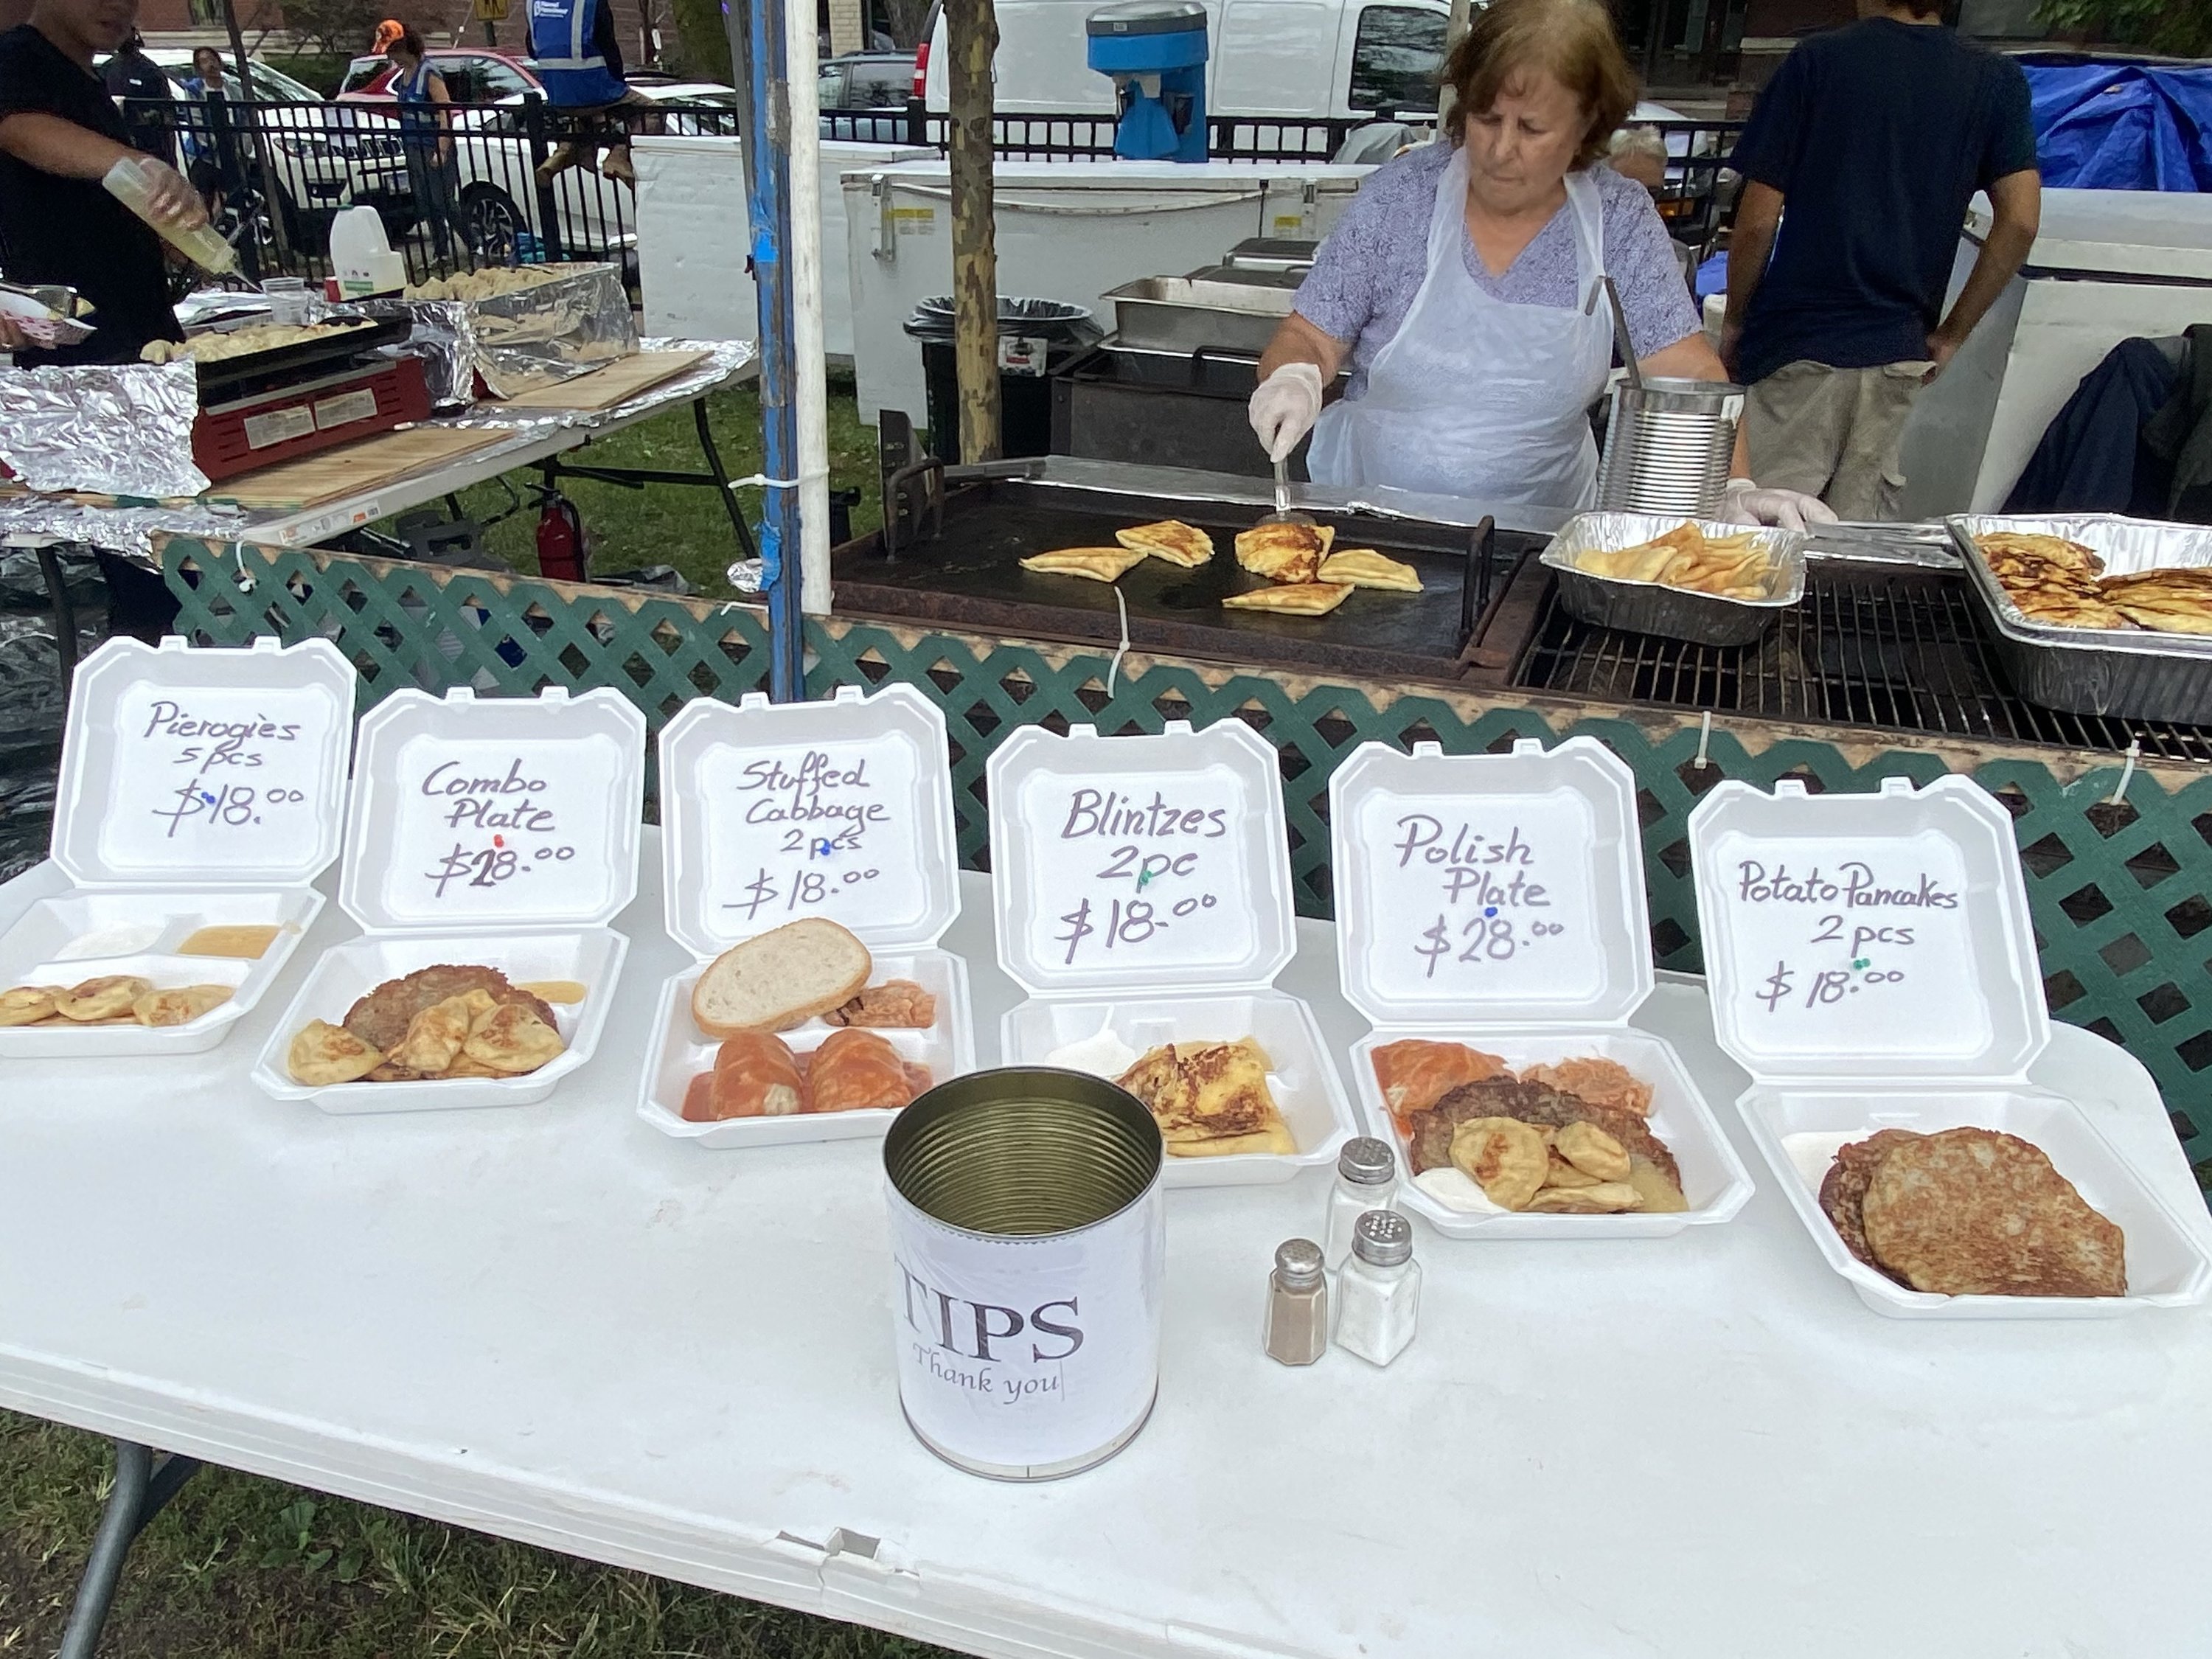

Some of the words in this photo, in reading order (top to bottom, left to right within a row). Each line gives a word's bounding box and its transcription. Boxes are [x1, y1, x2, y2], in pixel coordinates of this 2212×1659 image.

[421, 757, 548, 796] Combo
[736, 750, 871, 801] Stuffed
[443, 797, 556, 832] Plate
[745, 794, 891, 838] Cabbage
[1060, 788, 1227, 839] Blintzes
[1394, 813, 1535, 868] Polish
[1441, 866, 1551, 908] Plate
[1739, 860, 1838, 904] Potato
[1838, 861, 1959, 908] Pancakes
[894, 1251, 1085, 1363] TIPS
[912, 1342, 994, 1393] Thank
[1003, 1374, 1060, 1405] you
